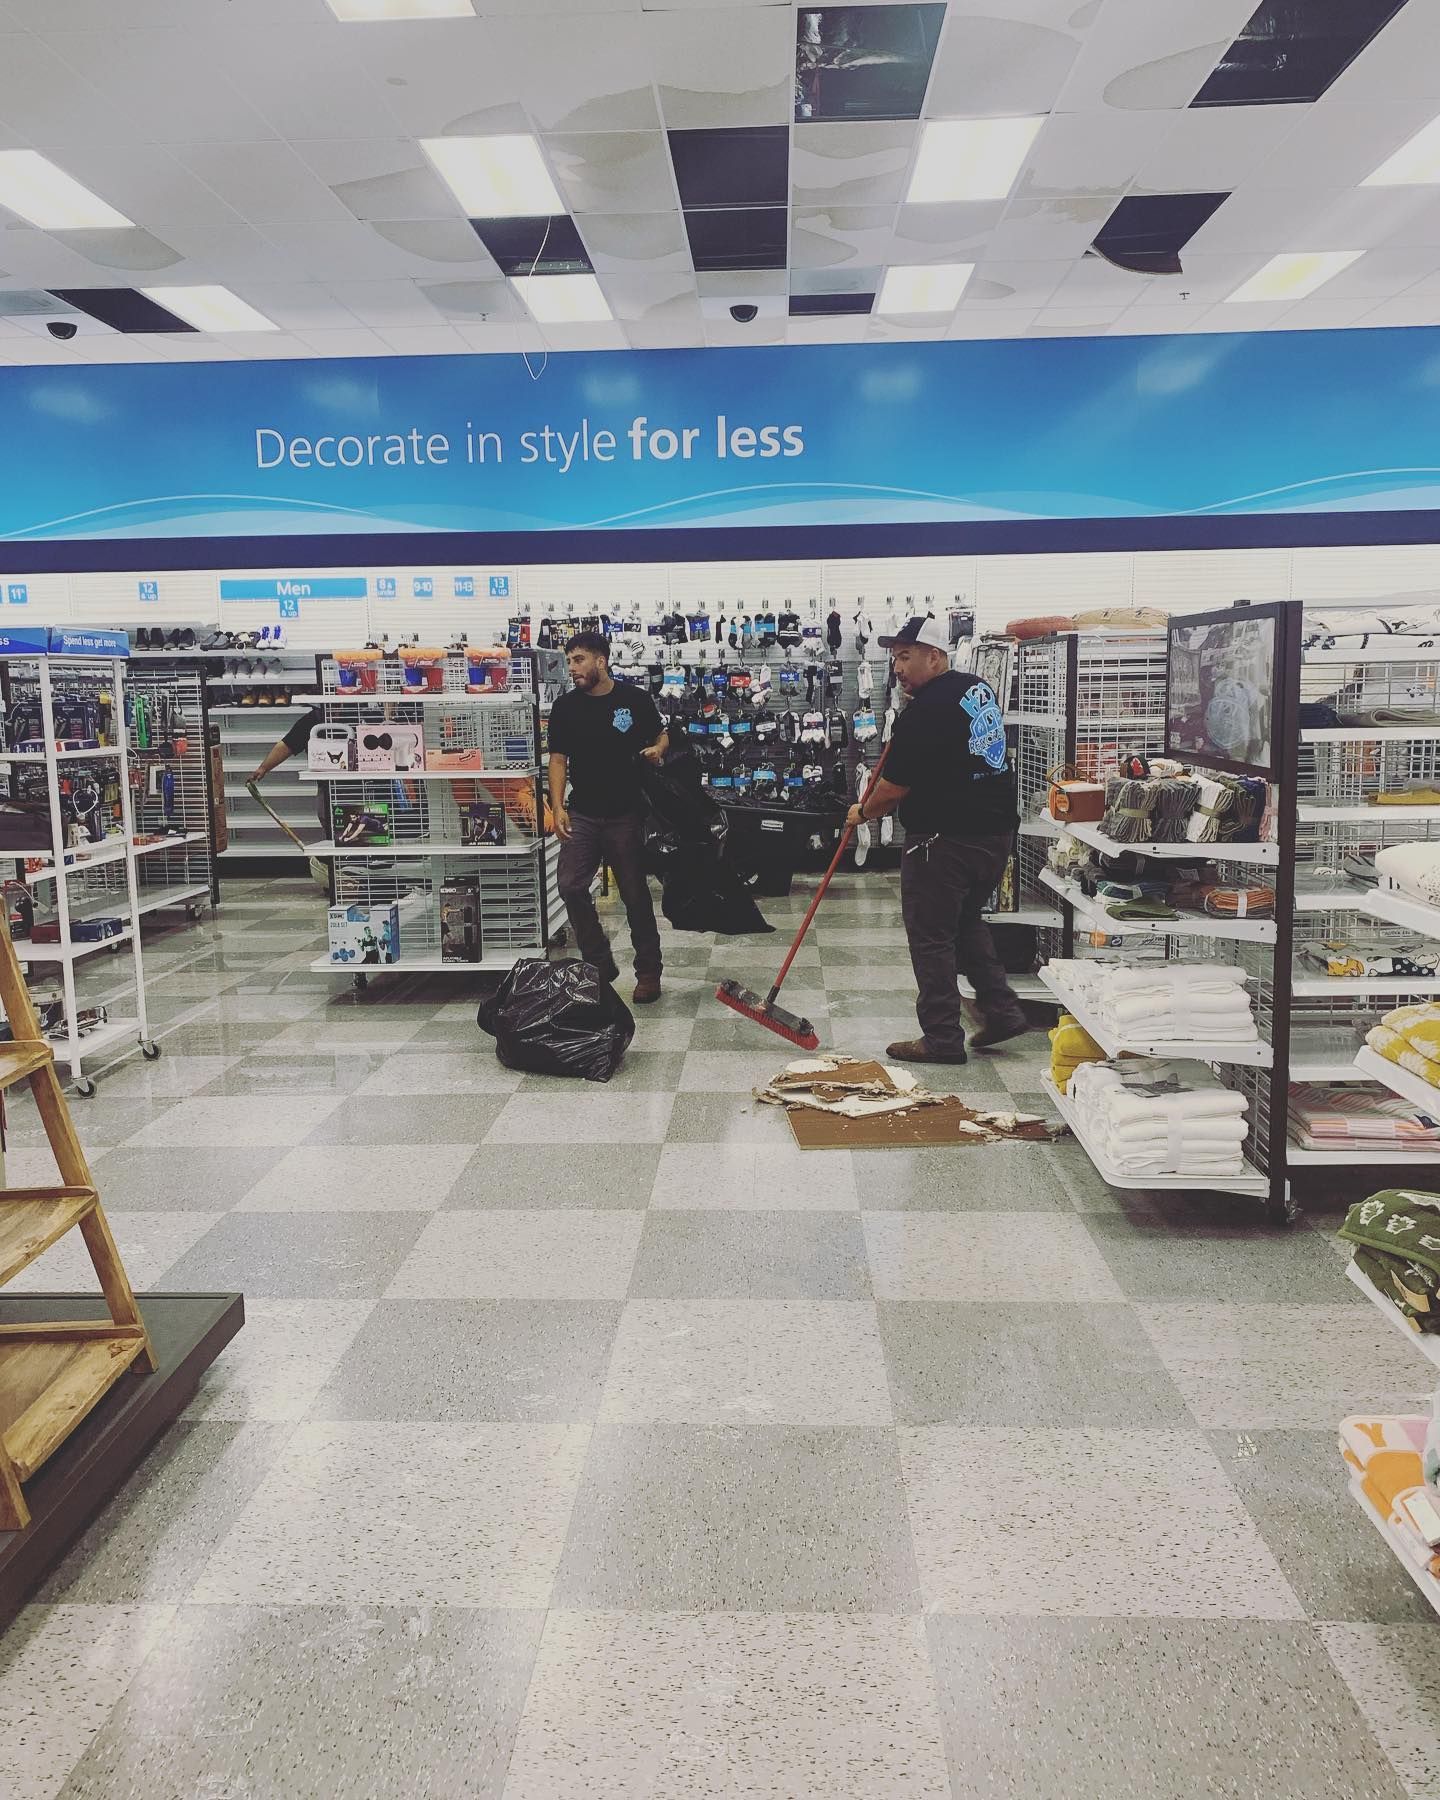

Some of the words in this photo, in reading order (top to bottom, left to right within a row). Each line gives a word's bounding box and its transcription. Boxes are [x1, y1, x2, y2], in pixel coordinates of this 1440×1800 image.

[255, 427, 449, 468] Decorate
[466, 422, 503, 463] in
[519, 418, 617, 473] style
[627, 416, 700, 460] for
[716, 415, 804, 458] less
[143, 583, 154, 593] 12
[276, 580, 311, 596] Men
[494, 577, 505, 589] 13
[283, 600, 295, 611] 12
[63, 635, 82, 647] Spend
[82, 636, 94, 646] less
[94, 638, 104, 649] get
[104, 639, 117, 648] more
